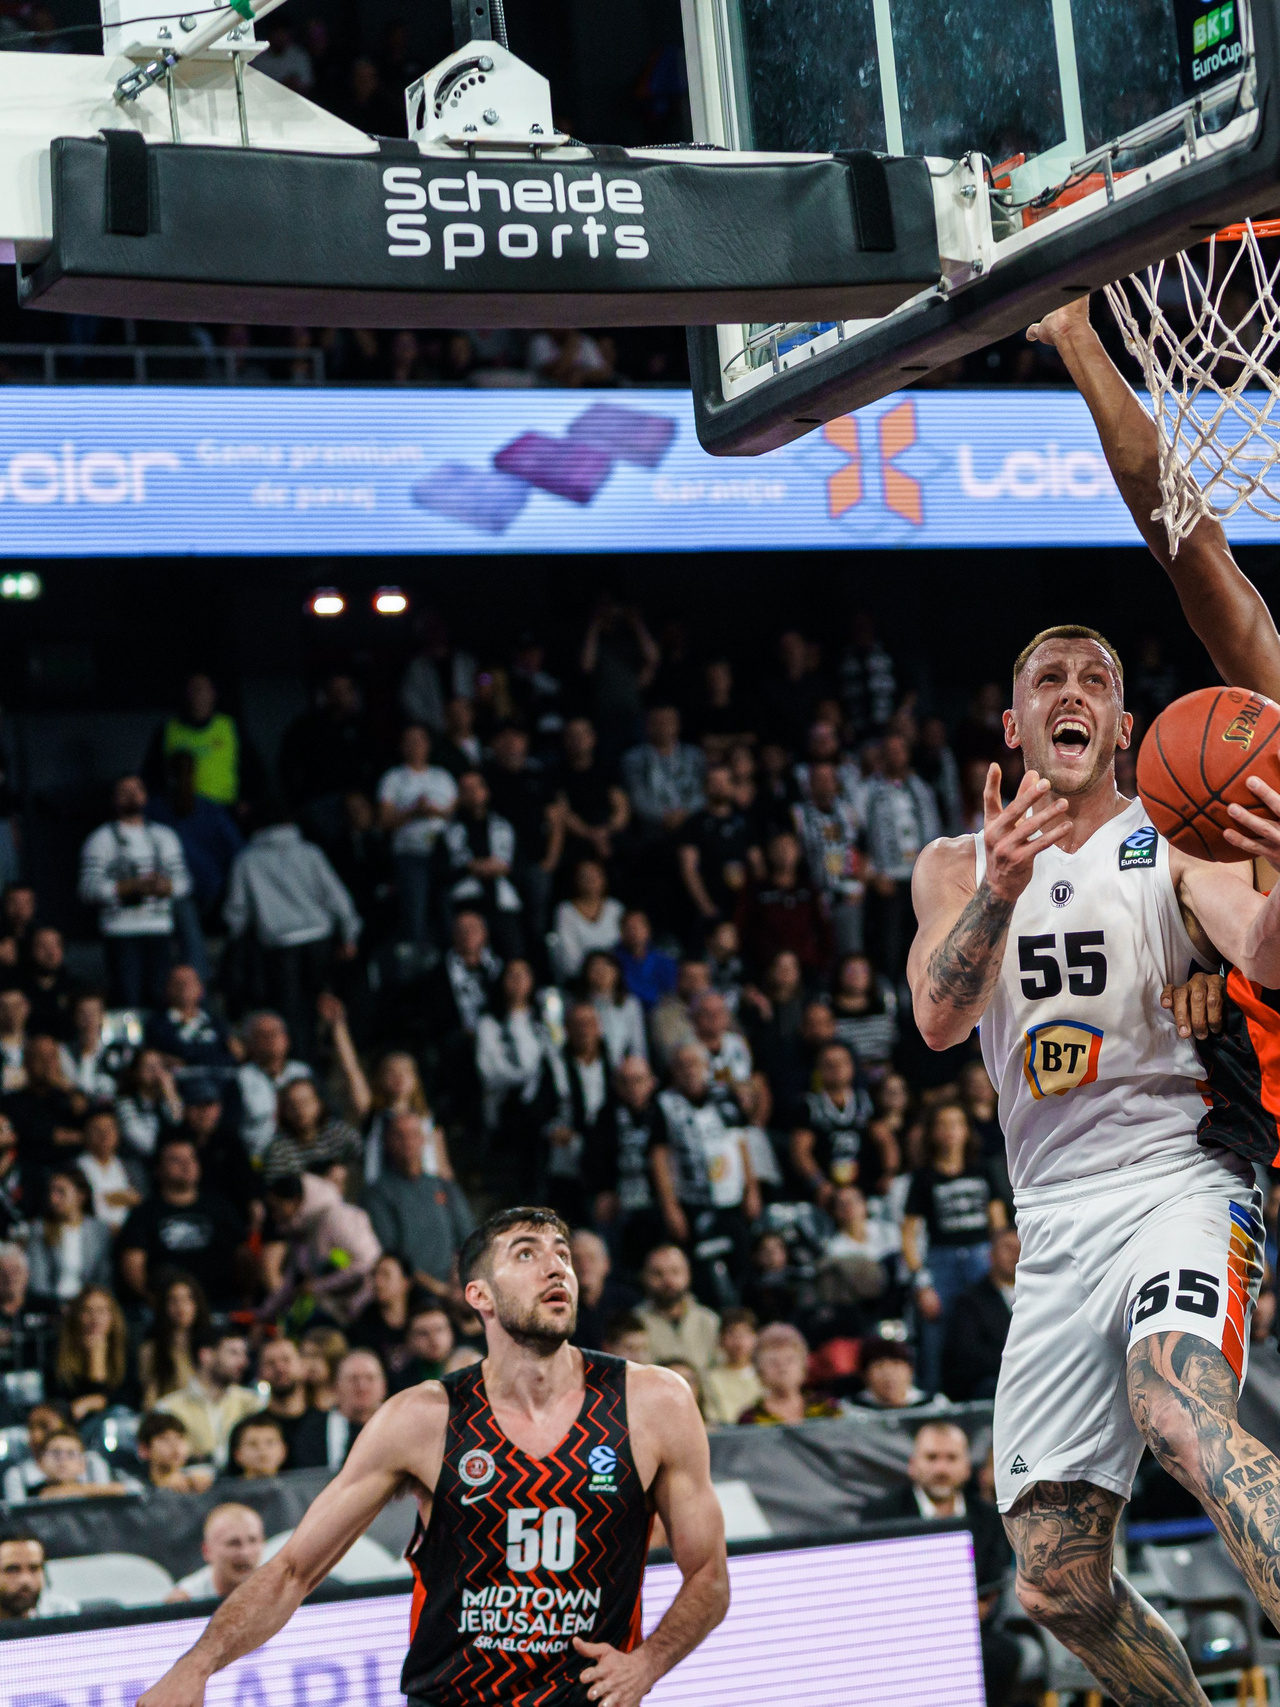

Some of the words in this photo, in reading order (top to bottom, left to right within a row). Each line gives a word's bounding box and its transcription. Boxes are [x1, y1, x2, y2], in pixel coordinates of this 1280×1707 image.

[1194, 7, 1233, 47] BKT
[1192, 41, 1242, 81] EuroCup
[382, 166, 644, 214] Schelde
[386, 213, 650, 270] Sports
[1121, 857, 1153, 866] EuroCup
[1055, 887, 1067, 901] U
[1018, 930, 1107, 1000] 55
[1040, 1041, 1086, 1073] BT
[1135, 1269, 1219, 1325] 55
[589, 1484, 617, 1492] EuroCup
[1010, 1466, 1029, 1475] PEAK
[506, 1506, 577, 1572] 50
[462, 1586, 601, 1611] MIDTOWN
[458, 1610, 596, 1635] JERUSALEM
